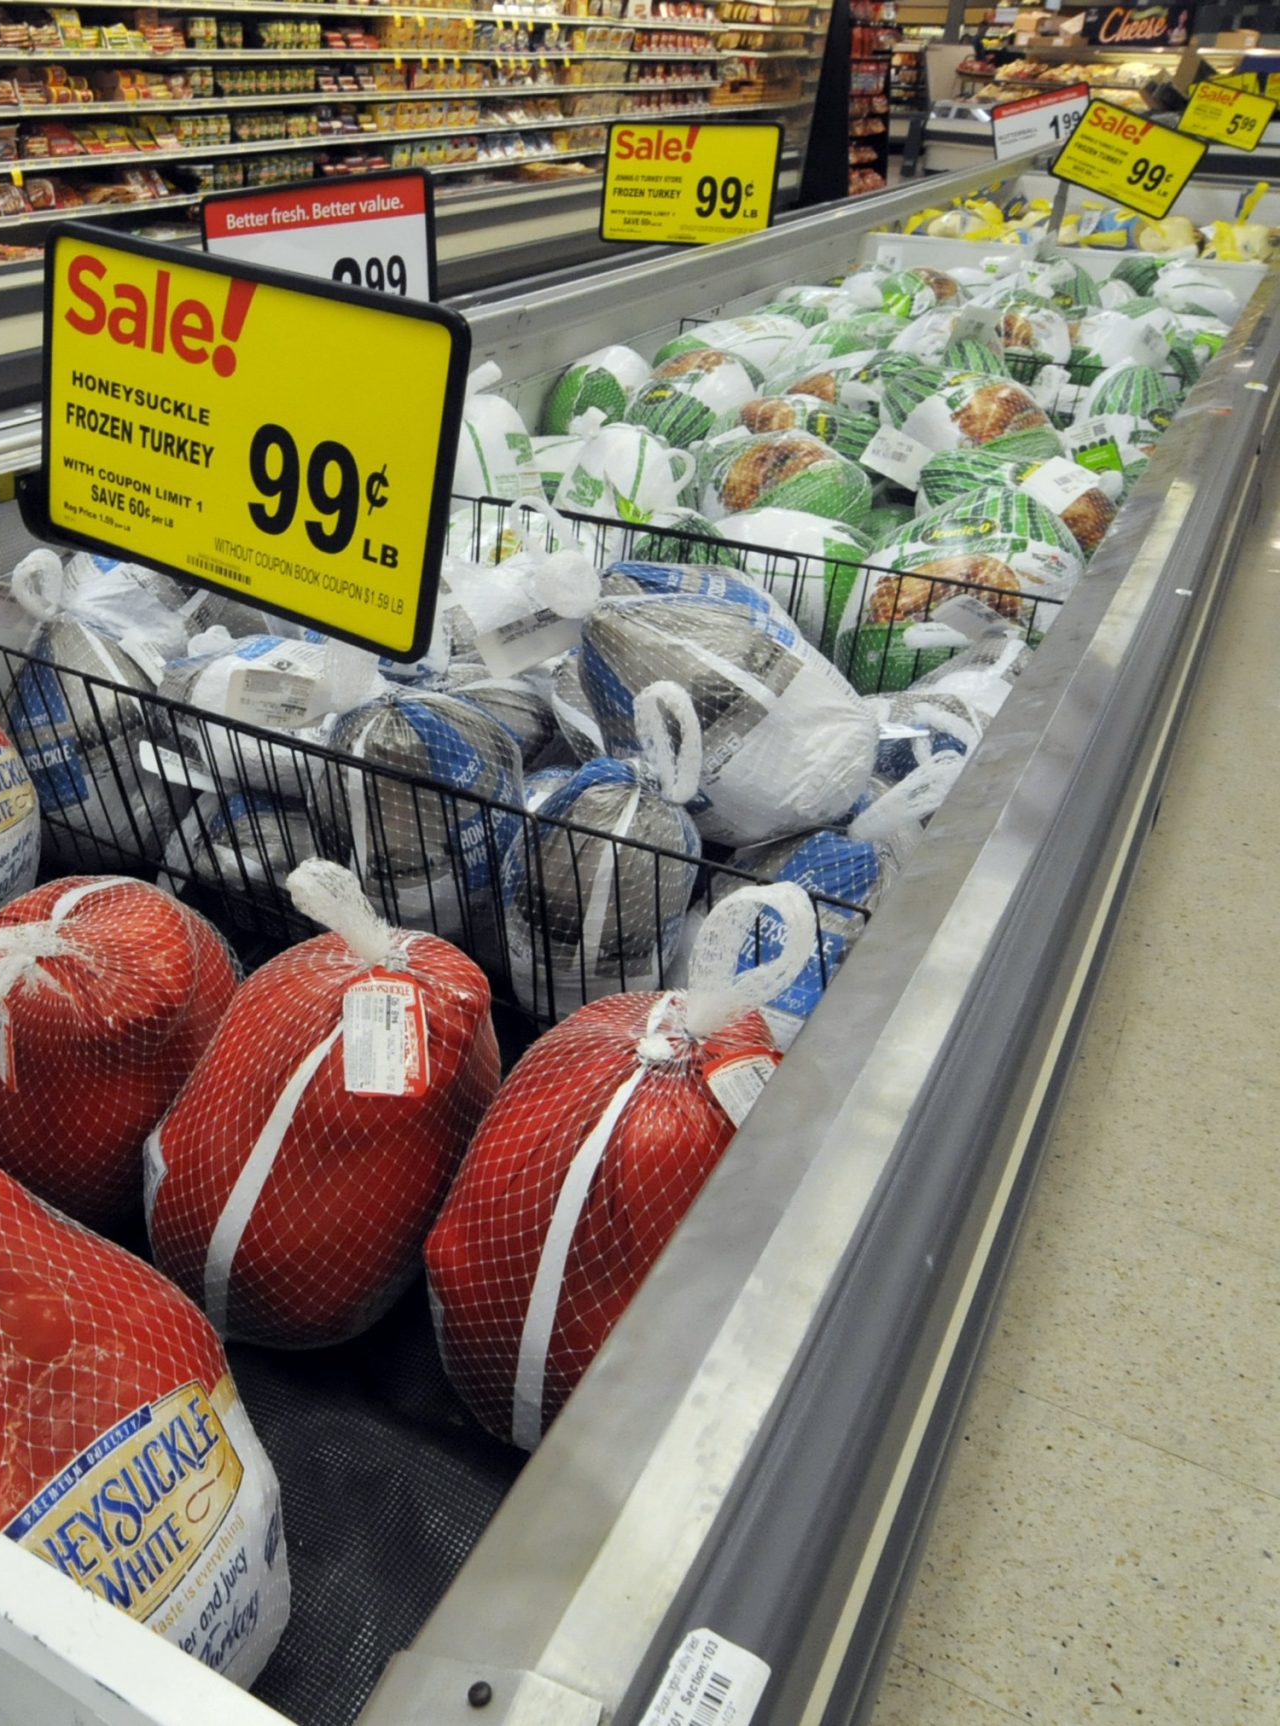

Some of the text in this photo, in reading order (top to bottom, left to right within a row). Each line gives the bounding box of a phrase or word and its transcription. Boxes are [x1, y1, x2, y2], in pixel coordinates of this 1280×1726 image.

[1099, 7, 1168, 43] Cheese
[1199, 85, 1243, 107] Sale!
[615, 125, 703, 164] Sale!
[1088, 106, 1155, 145] Sale!
[226, 193, 404, 230] Better fresh. Better value.
[612, 187, 682, 200] FROZEN TURKEY
[695, 175, 755, 219] 99¢
[742, 210, 758, 219] LB
[65, 254, 258, 377] Sale!
[72, 370, 211, 426] HONEYSUCKLE
[66, 402, 215, 468] FROZEN TURKEY
[63, 456, 203, 512] WITH COUPON LIMIT 1
[91, 484, 174, 528] SAVE 60¢ per LB
[247, 423, 390, 555] 99¢
[78, 506, 98, 520] Price
[214, 536, 254, 564] WITHOUT
[255, 551, 293, 577] COUPON
[294, 563, 321, 585] BOOK
[322, 573, 362, 601] COUPON
[363, 587, 389, 610] $1.59
[391, 598, 404, 615] LB
[362, 538, 399, 569] LB
[23, 1417, 138, 1525] PREMIUM QUALITY
[94, 1512, 190, 1610] WHITE
[184, 1585, 196, 1602] is
[195, 1513, 245, 1588] everything
[199, 1581, 223, 1631] and
[220, 1546, 248, 1604] Juicy
[680, 1660, 709, 1706] Section:
[703, 1639, 719, 1665] 103
